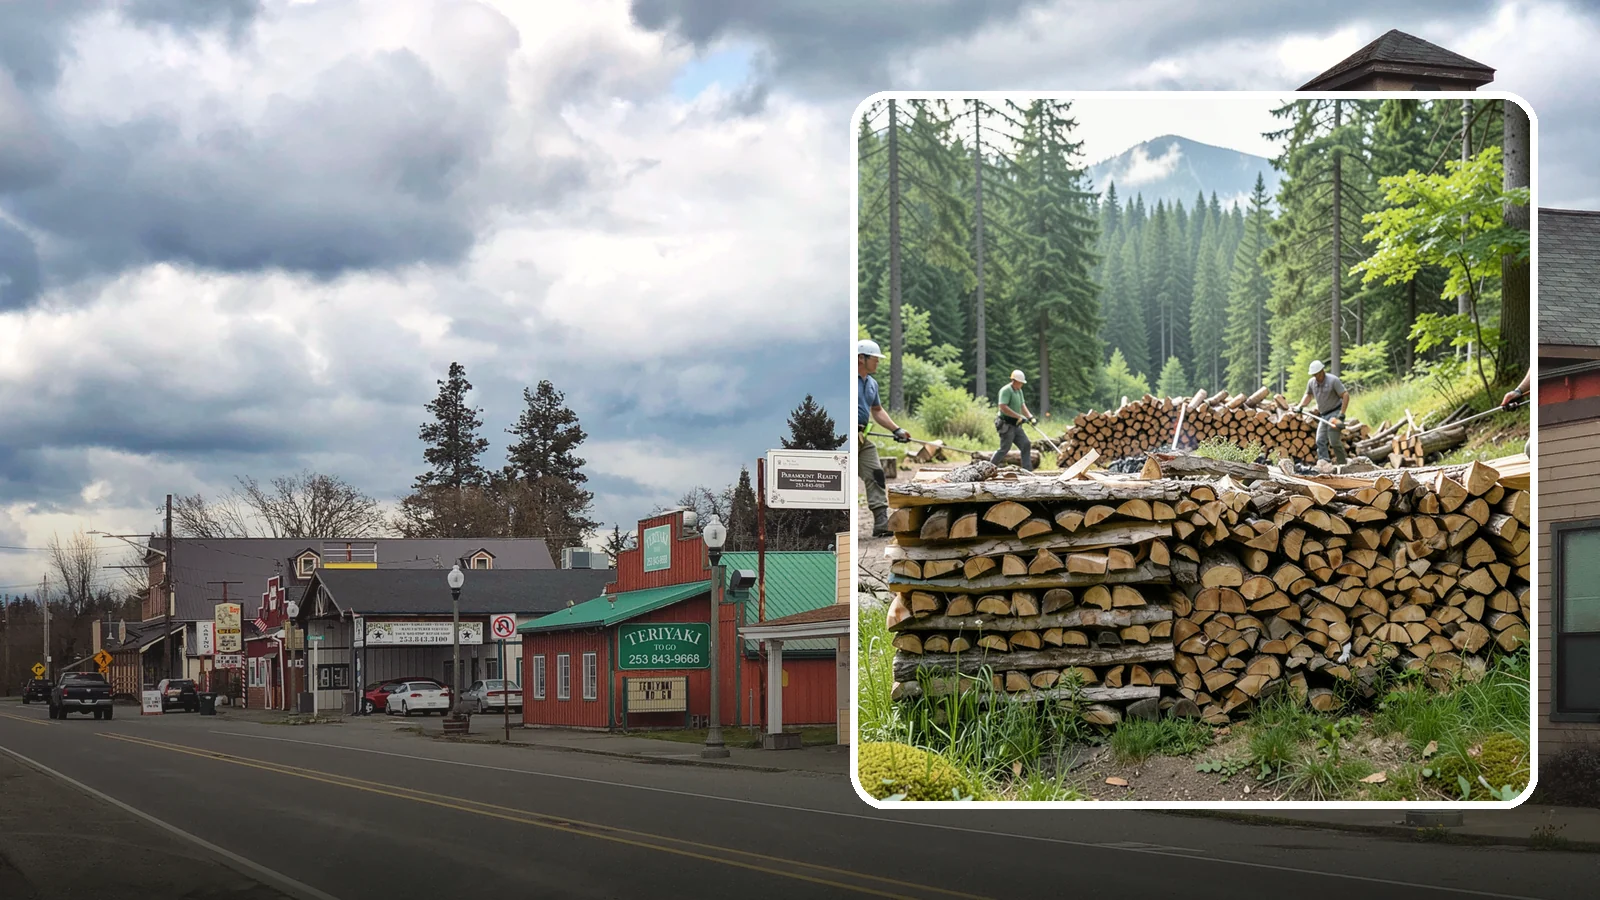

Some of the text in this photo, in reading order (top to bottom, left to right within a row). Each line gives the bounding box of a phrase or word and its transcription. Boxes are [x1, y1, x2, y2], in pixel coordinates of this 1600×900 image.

[781, 471, 839, 480] PARAMOUNT REALTY
[625, 627, 702, 646] TERIYAKI
[629, 654, 700, 664] 253 843-9668
